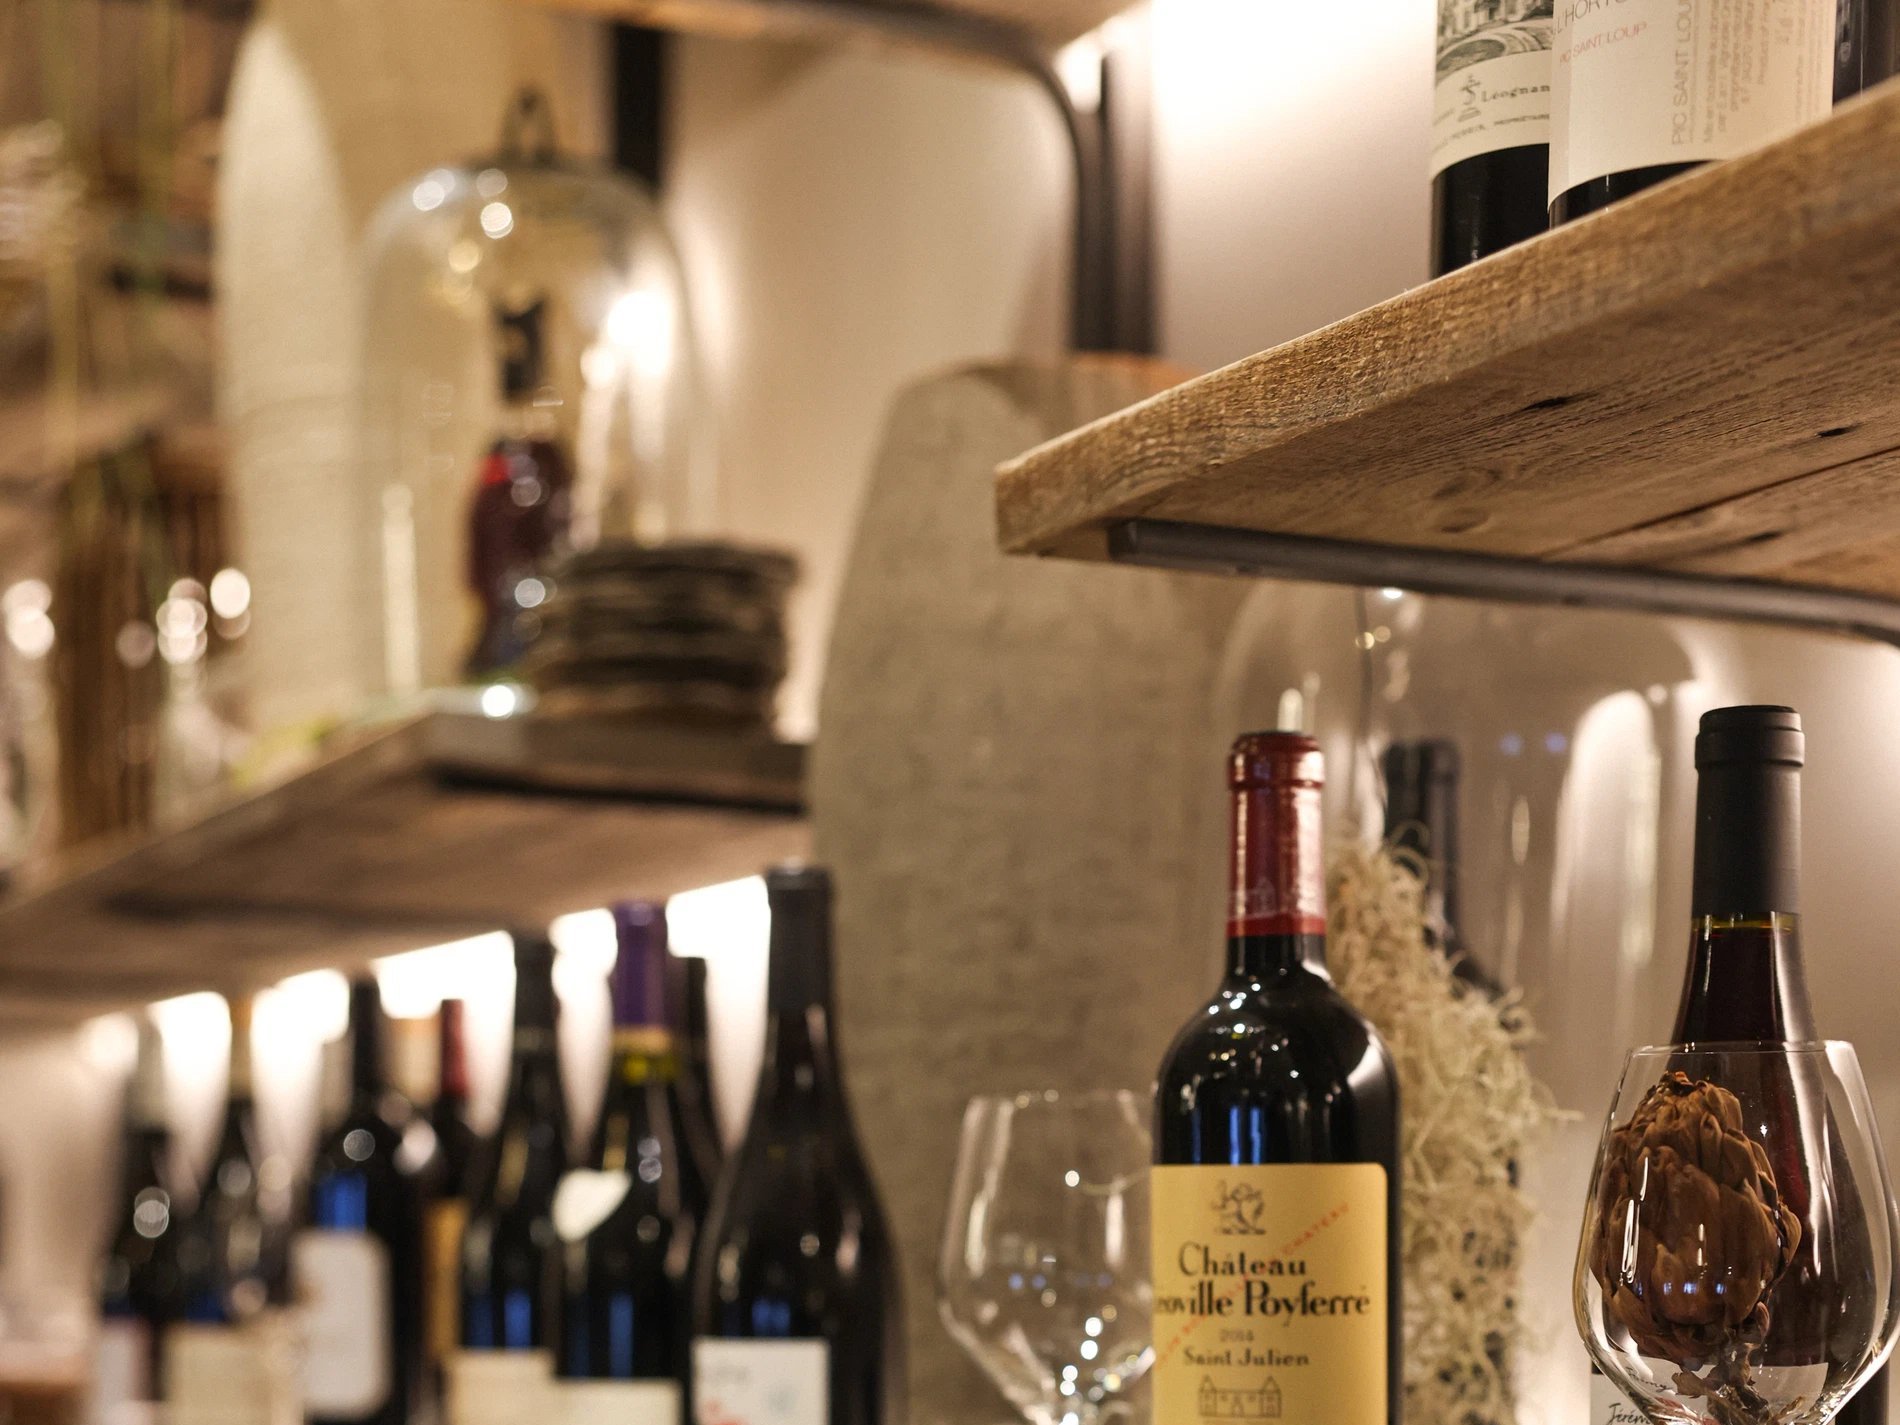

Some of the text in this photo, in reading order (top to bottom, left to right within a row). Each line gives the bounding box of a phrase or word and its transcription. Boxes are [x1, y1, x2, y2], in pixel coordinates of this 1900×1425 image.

[1573, 33, 1602, 57] SAINT
[1672, 0, 1692, 145] PIC SAINT LOU
[1183, 1347, 1311, 1367] Saint Julien
